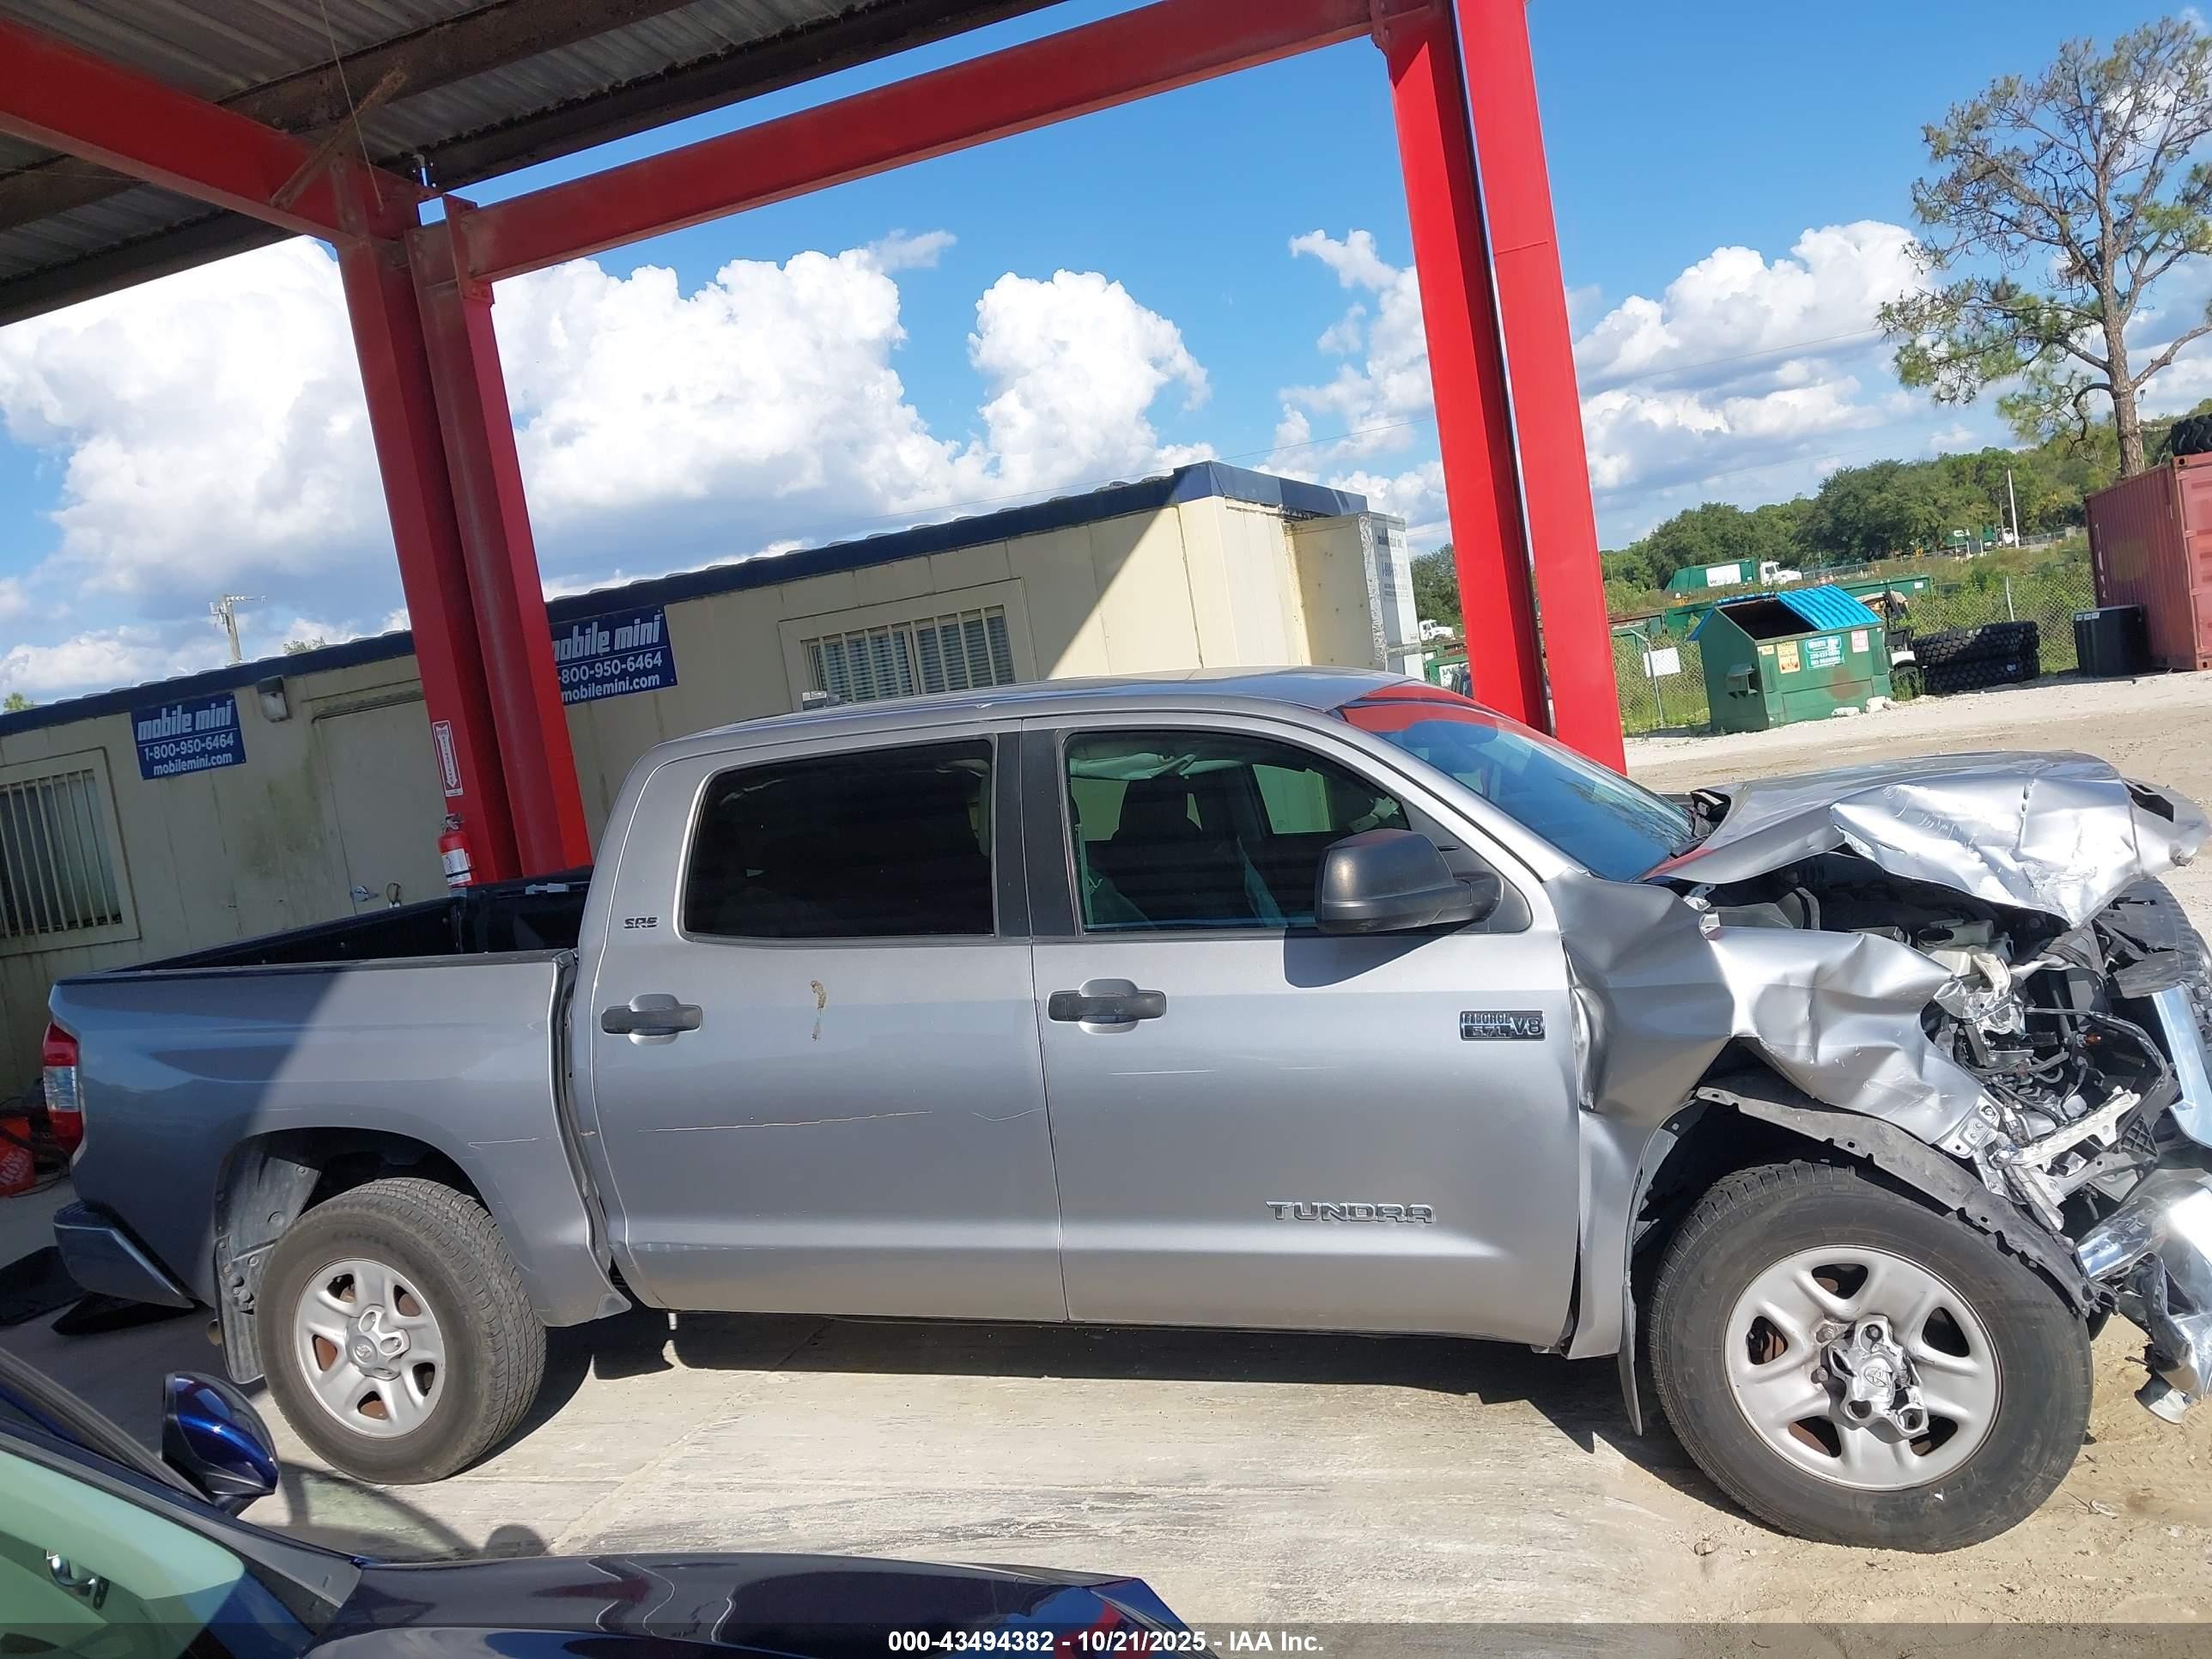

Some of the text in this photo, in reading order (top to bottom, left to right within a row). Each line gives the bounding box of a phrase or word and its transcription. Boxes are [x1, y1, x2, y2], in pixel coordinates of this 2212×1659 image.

[614, 615, 660, 650] mini
[558, 651, 663, 684] -800-950-6464
[562, 674, 660, 702] mobilemini.com
[137, 701, 232, 741] mobile mini
[143, 732, 234, 761] 1-800-950-6464
[153, 752, 233, 775] mobilemini.com
[1510, 1016, 1543, 1036] V8
[1266, 1201, 1436, 1223] TUNDRA
